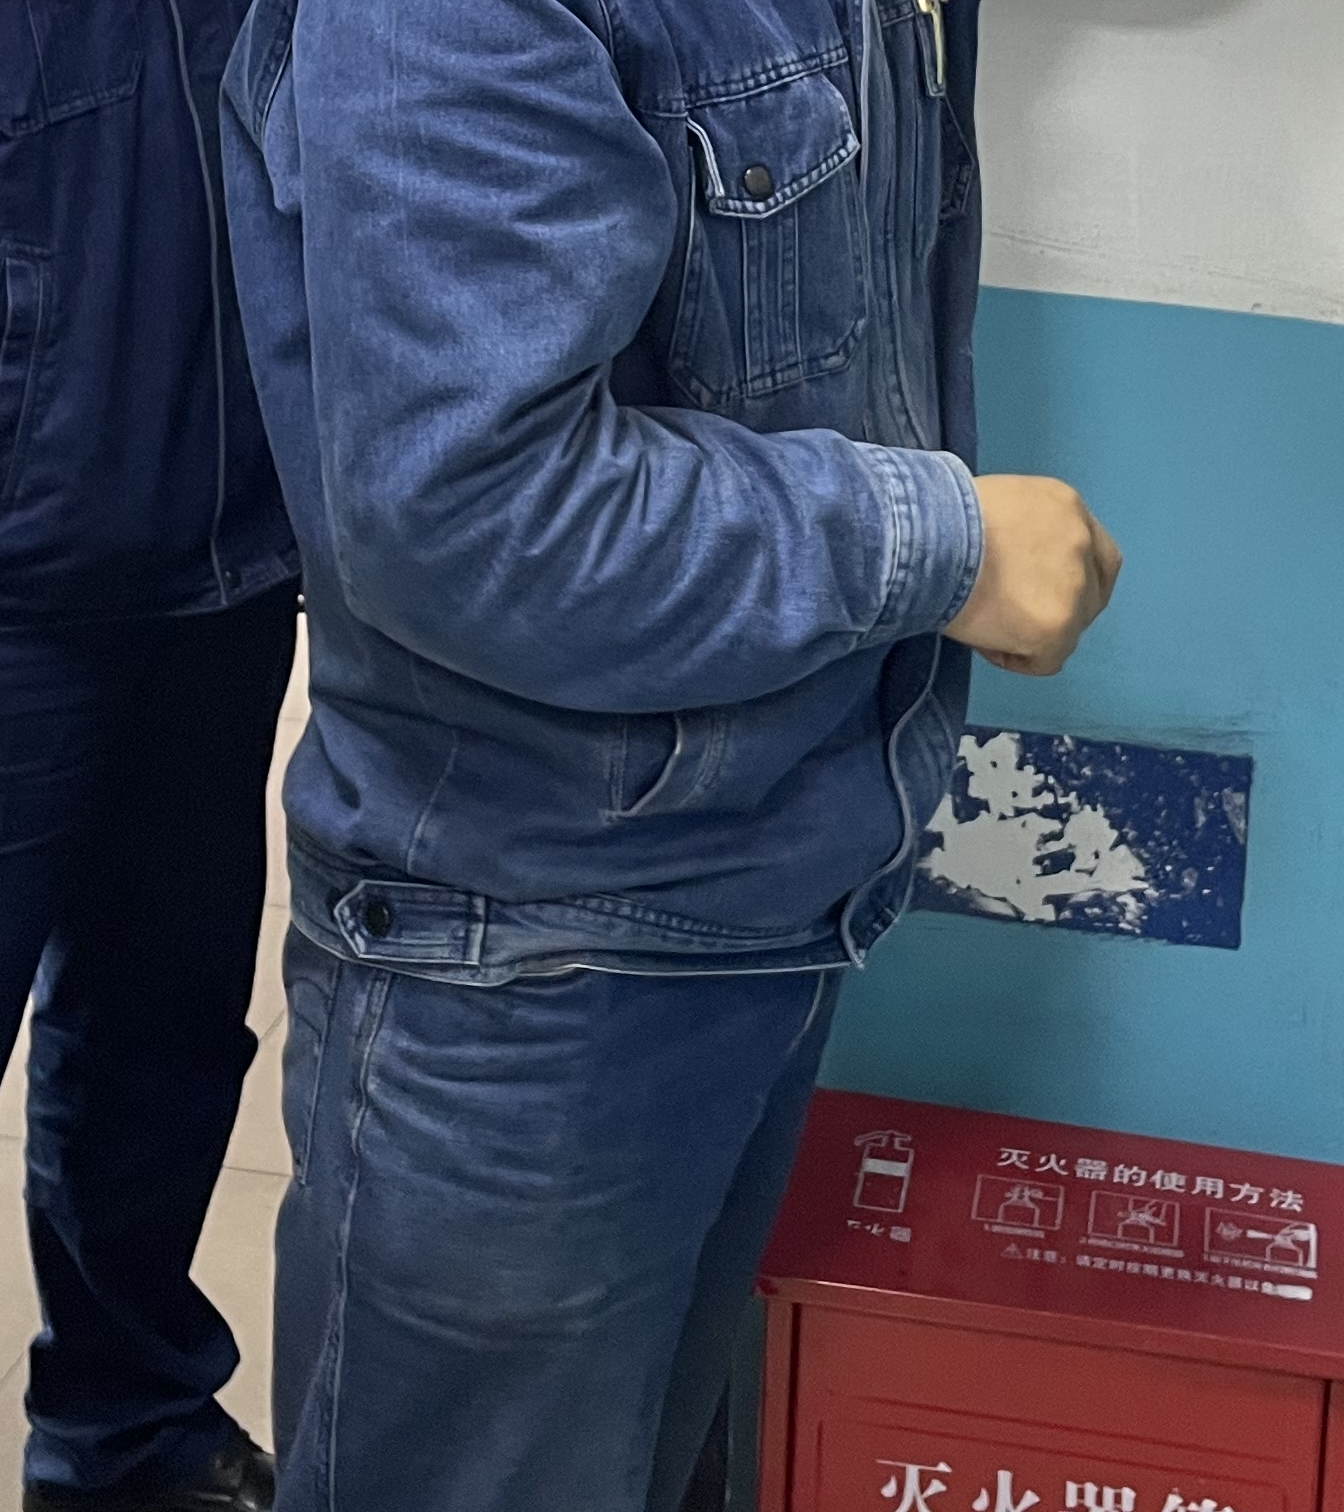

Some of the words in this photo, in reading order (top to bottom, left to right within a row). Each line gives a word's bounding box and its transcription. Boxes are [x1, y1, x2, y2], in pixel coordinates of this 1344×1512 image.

[996, 1147, 1304, 1213] 灭火器的使用方法
[875, 1458, 1236, 1512] 灭火
